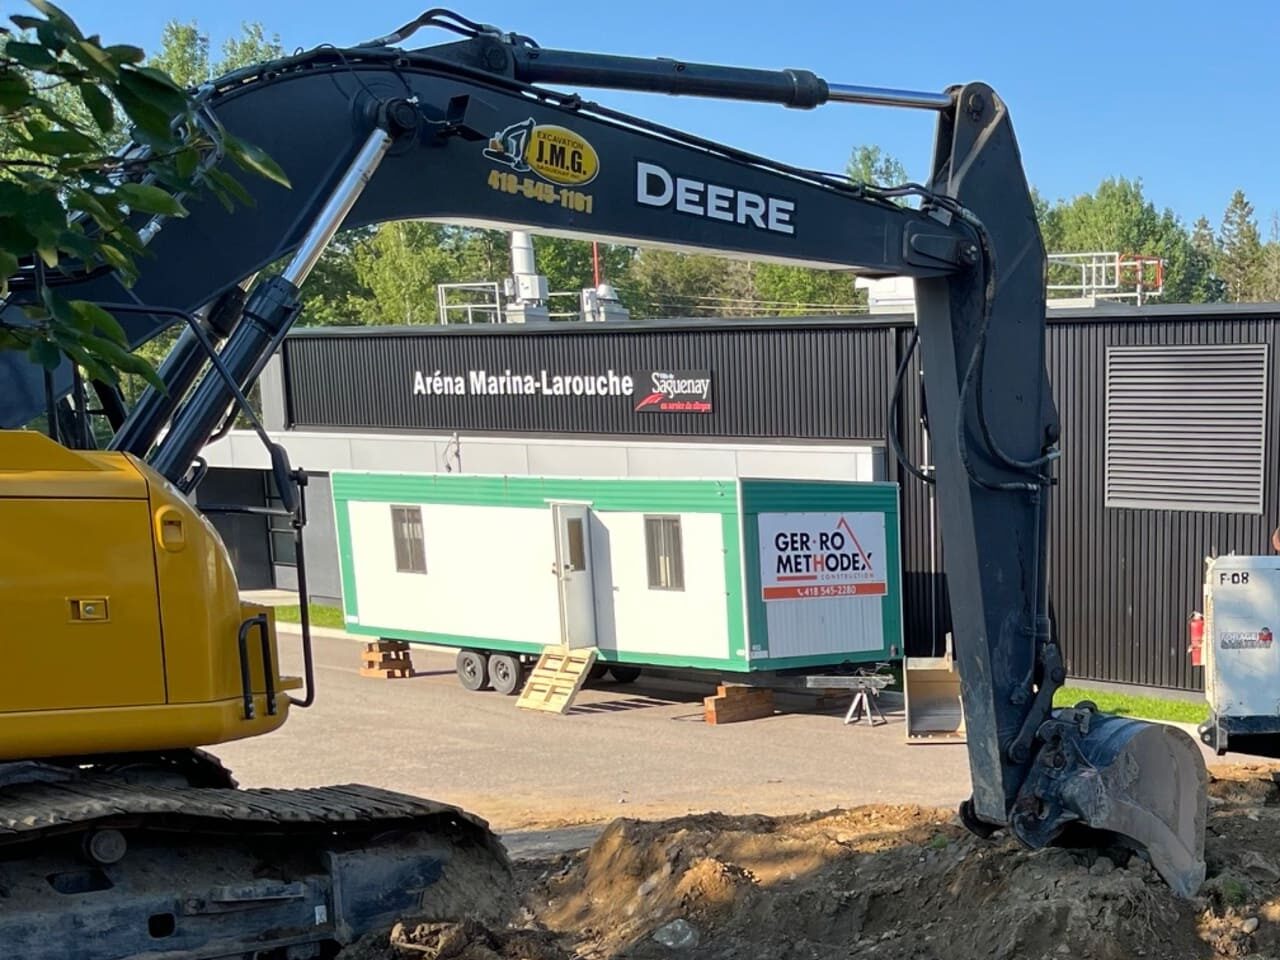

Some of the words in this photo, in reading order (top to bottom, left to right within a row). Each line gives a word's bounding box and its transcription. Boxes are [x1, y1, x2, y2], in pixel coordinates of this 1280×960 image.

[537, 131, 584, 150] EXCAVATION
[536, 140, 587, 175] J.M.G.
[636, 161, 795, 234] DEERE
[413, 369, 465, 396] Aréna
[469, 368, 634, 396] Marina-Larouche
[651, 371, 711, 400] Saguenay
[776, 552, 873, 574] METHODEX
[821, 573, 874, 581] CONSTRUCTION
[1219, 571, 1250, 586] F-08
